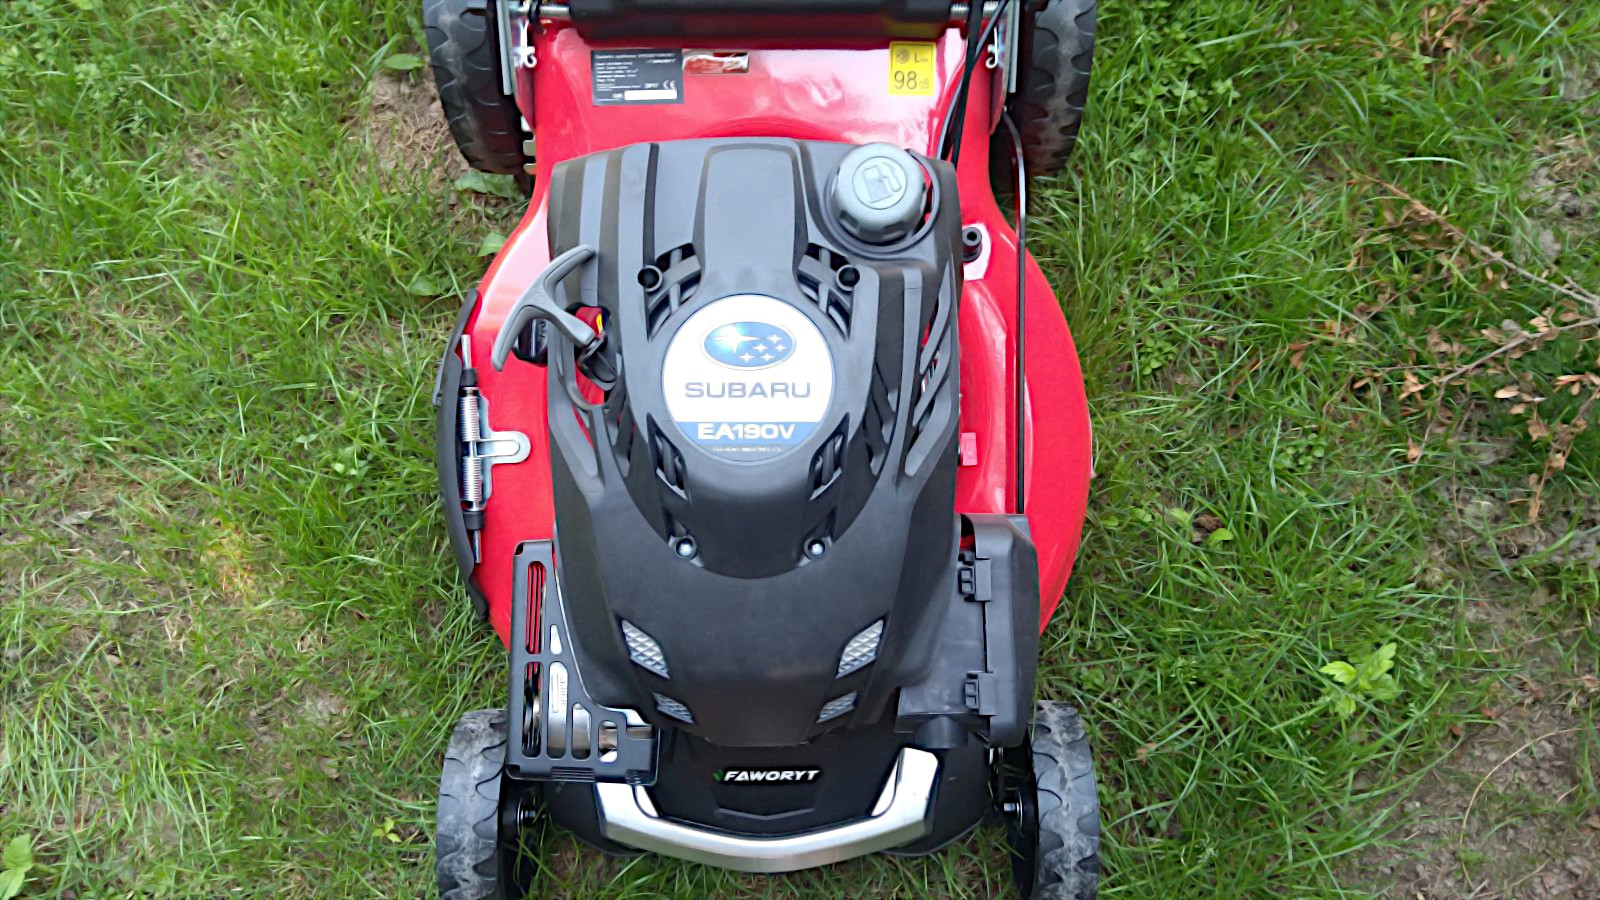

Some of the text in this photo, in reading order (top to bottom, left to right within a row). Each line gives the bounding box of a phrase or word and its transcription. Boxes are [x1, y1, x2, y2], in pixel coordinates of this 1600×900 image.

[894, 70, 917, 90] 98
[685, 382, 811, 398] SUBARU
[698, 423, 796, 440] EA190V
[723, 770, 820, 782] FAWORYT
